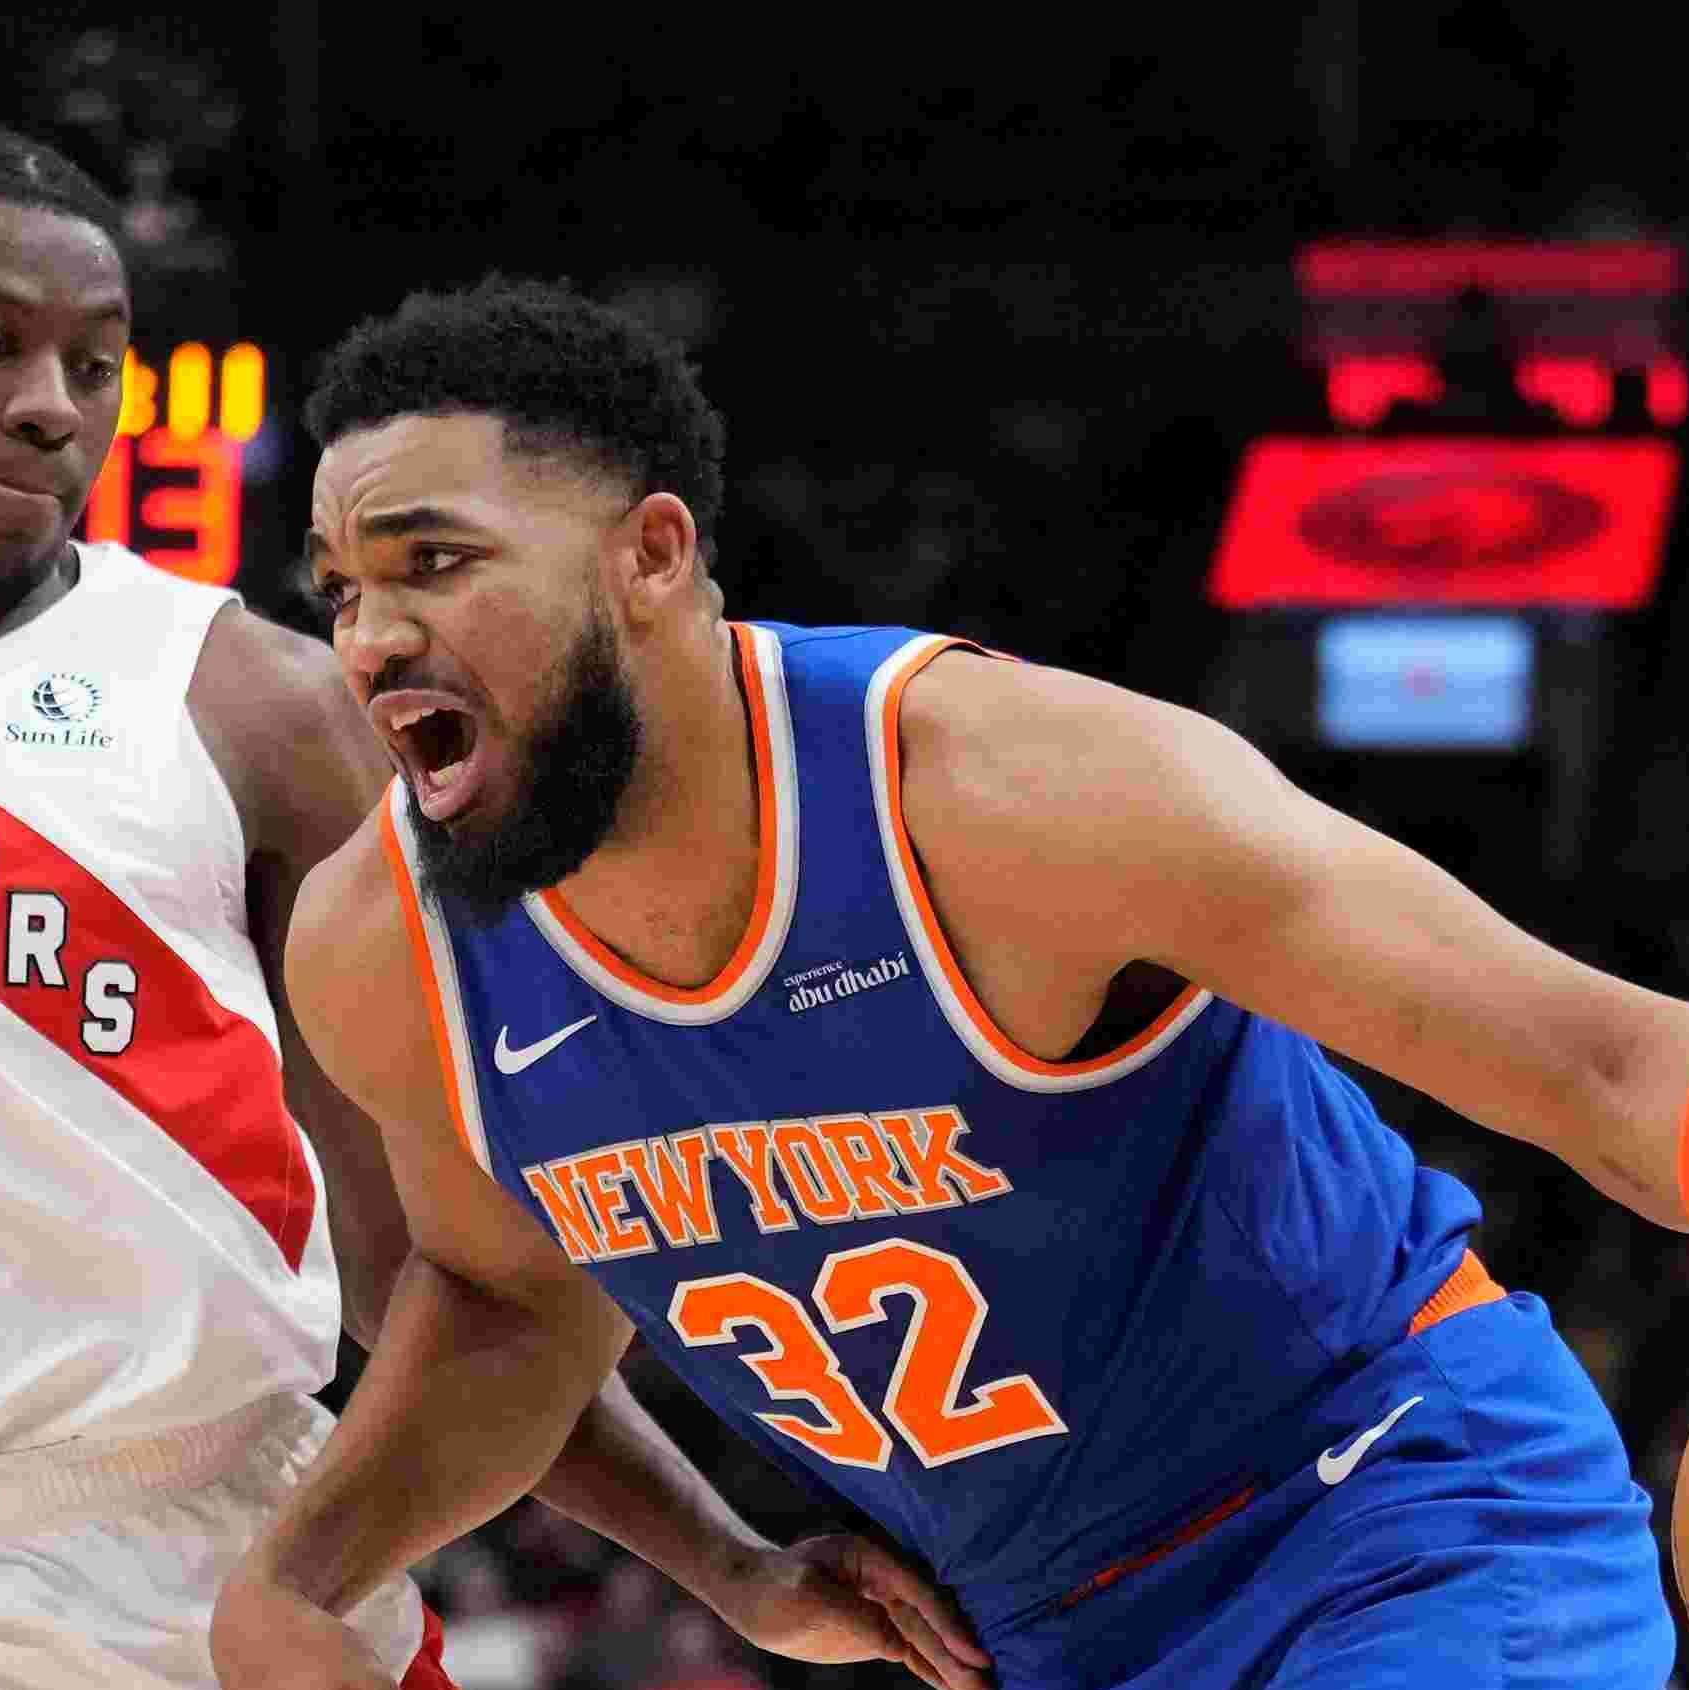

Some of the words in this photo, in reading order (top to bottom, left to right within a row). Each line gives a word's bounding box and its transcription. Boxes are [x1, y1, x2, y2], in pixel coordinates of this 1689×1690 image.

[5, 723, 55, 744] Sun
[62, 728, 116, 750] Life
[783, 960, 844, 988] experience
[789, 983, 834, 1013] abu
[835, 951, 910, 998] dhabi
[521, 1130, 722, 1265] NEW
[708, 1105, 1015, 1234] YORK
[667, 1237, 1070, 1472] 32
